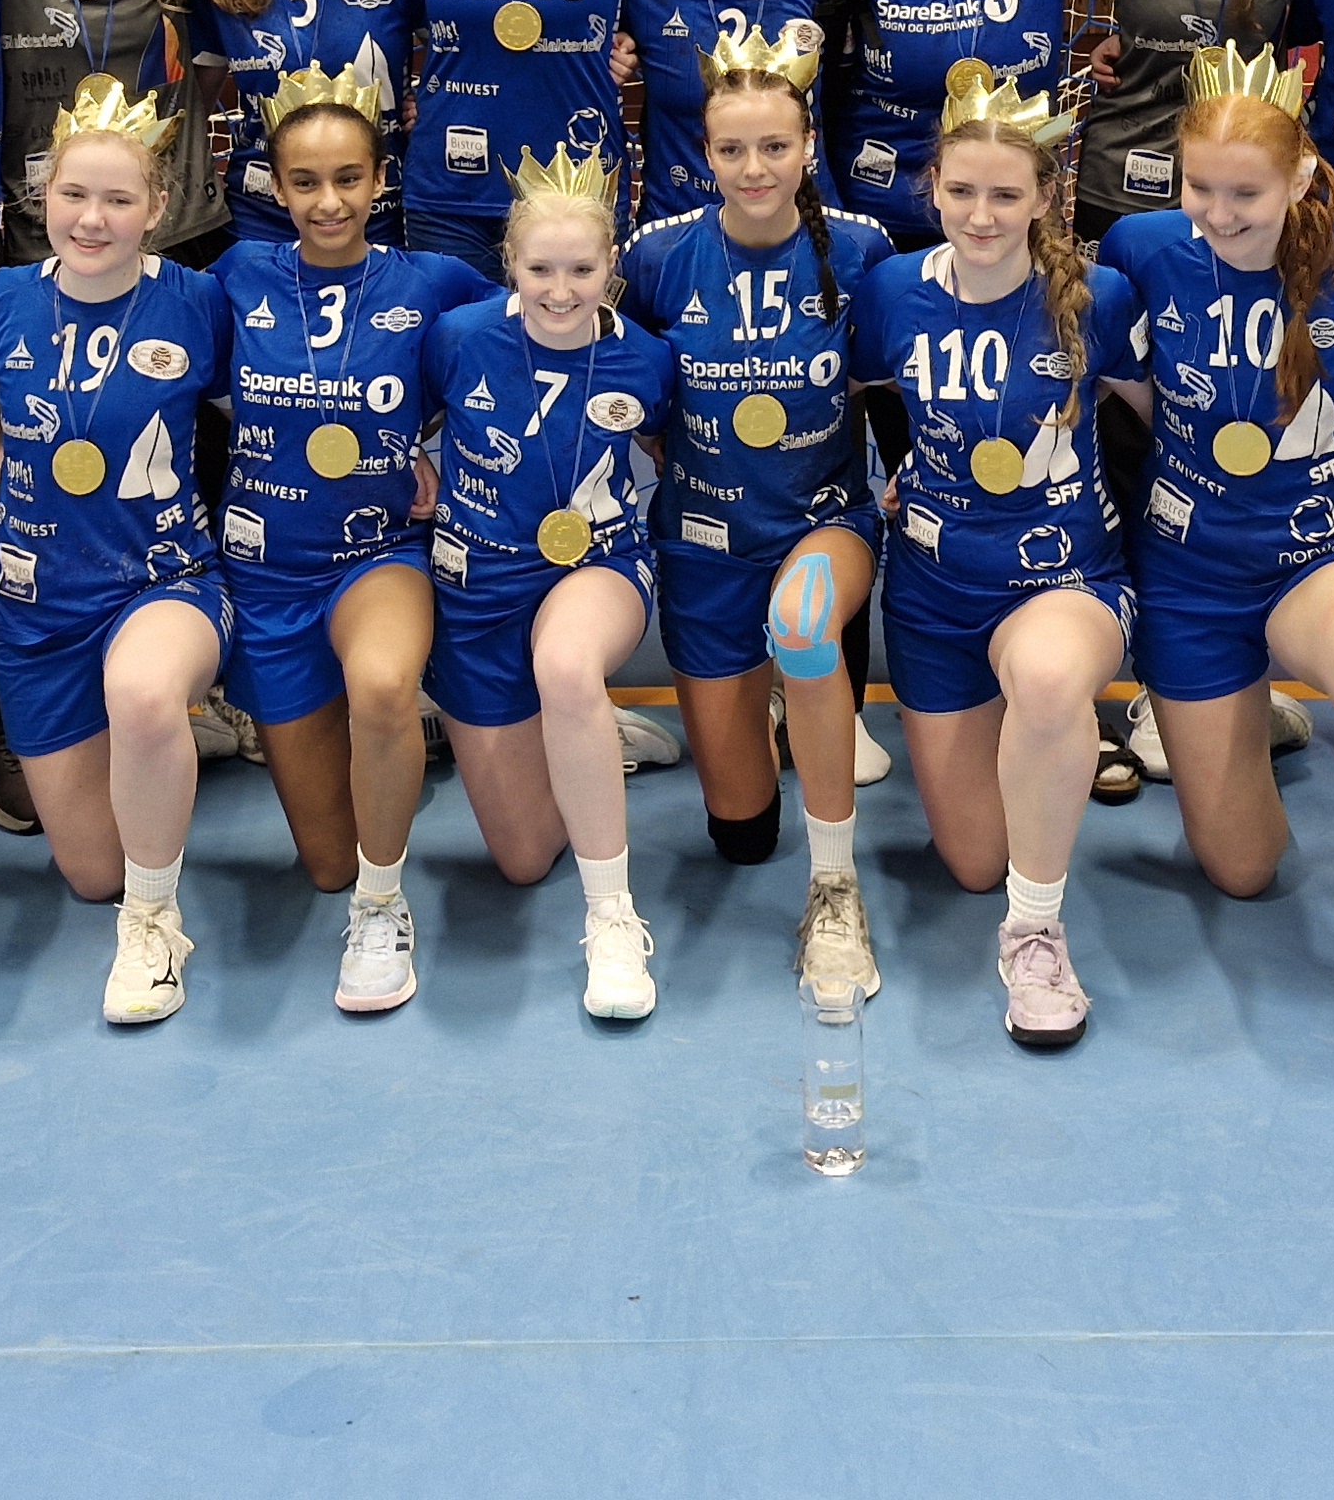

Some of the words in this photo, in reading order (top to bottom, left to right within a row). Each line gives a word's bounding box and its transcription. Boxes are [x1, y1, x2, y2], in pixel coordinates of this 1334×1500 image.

[662, 29, 689, 37] SELECT
[717, 8, 747, 48] 2
[879, 20, 906, 32] SOGN
[908, 23, 924, 32] OG
[445, 80, 499, 96] ENIVEST
[450, 137, 483, 150] Bistro
[1131, 159, 1168, 175] Bistro
[310, 284, 346, 349] 3
[728, 269, 791, 342] 15
[245, 317, 276, 329] SELECT
[681, 313, 709, 324] SELECT
[1156, 318, 1184, 333] SELECT
[1206, 294, 1284, 370] 10
[5, 360, 34, 369] SELECT
[49, 323, 120, 392] 19
[680, 354, 805, 379] SpareBank
[239, 366, 363, 397] SpareBank
[686, 378, 716, 391] SOGN
[720, 381, 738, 391] OG
[242, 391, 270, 405] SOGN
[273, 396, 292, 407] OG
[464, 398, 495, 411] SELECT
[524, 369, 569, 437] 7
[1168, 454, 1226, 497] ENIVEST
[245, 479, 308, 501] ENIVEST
[690, 477, 745, 501] ENIVEST
[1154, 488, 1186, 520] Bistro
[9, 514, 57, 537] ENIVEST
[156, 502, 185, 532] SFE
[229, 517, 260, 540] Bistro
[686, 523, 723, 544] Bistro
[434, 541, 463, 566] Bistro
